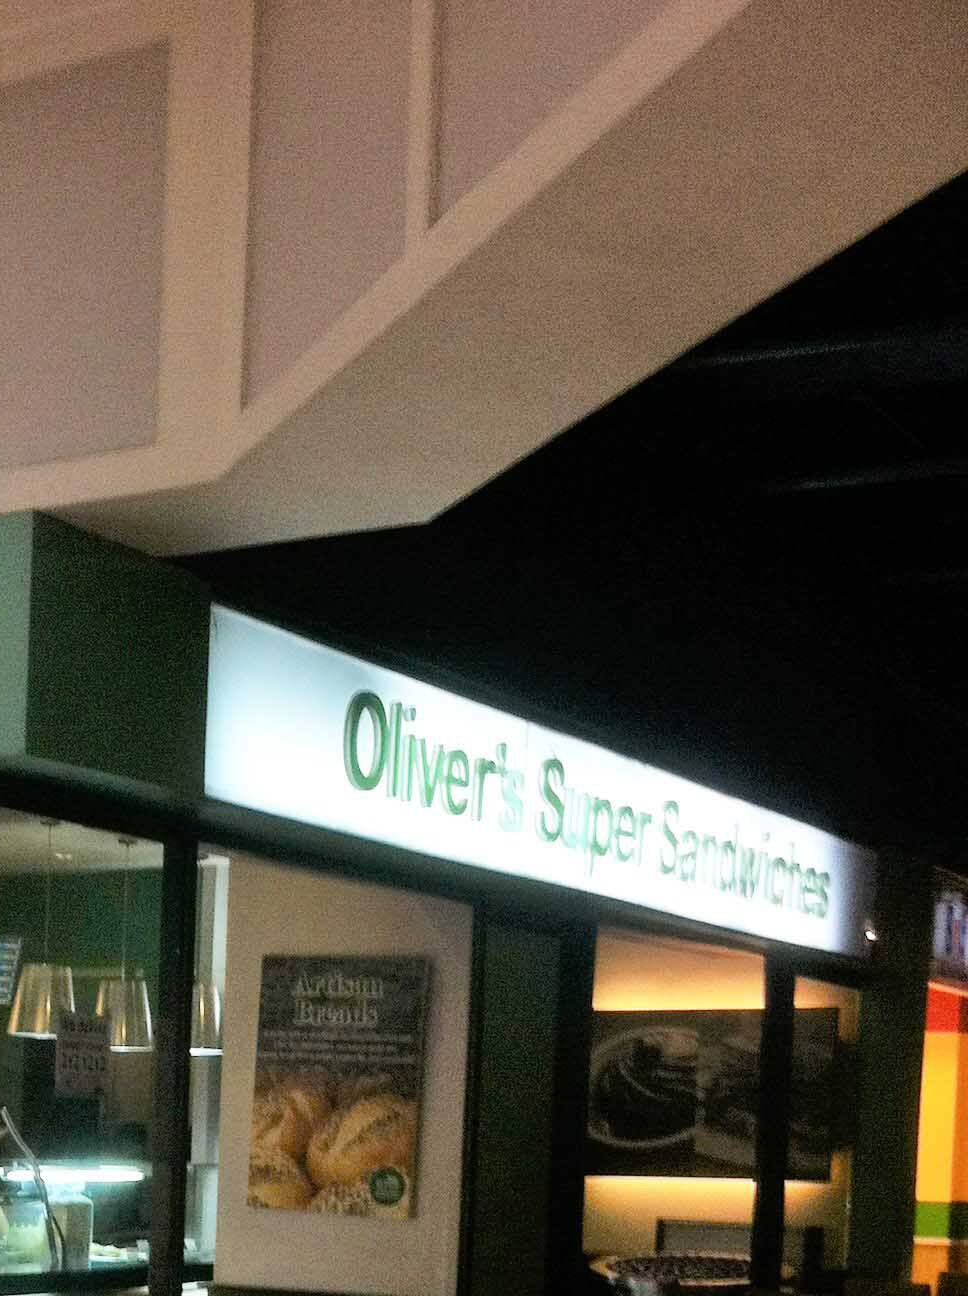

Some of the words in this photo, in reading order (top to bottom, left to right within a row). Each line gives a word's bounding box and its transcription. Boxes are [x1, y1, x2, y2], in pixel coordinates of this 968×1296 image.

[343, 689, 525, 832] Oliver's
[536, 757, 652, 874] Super
[659, 800, 831, 920] Sandwiches
